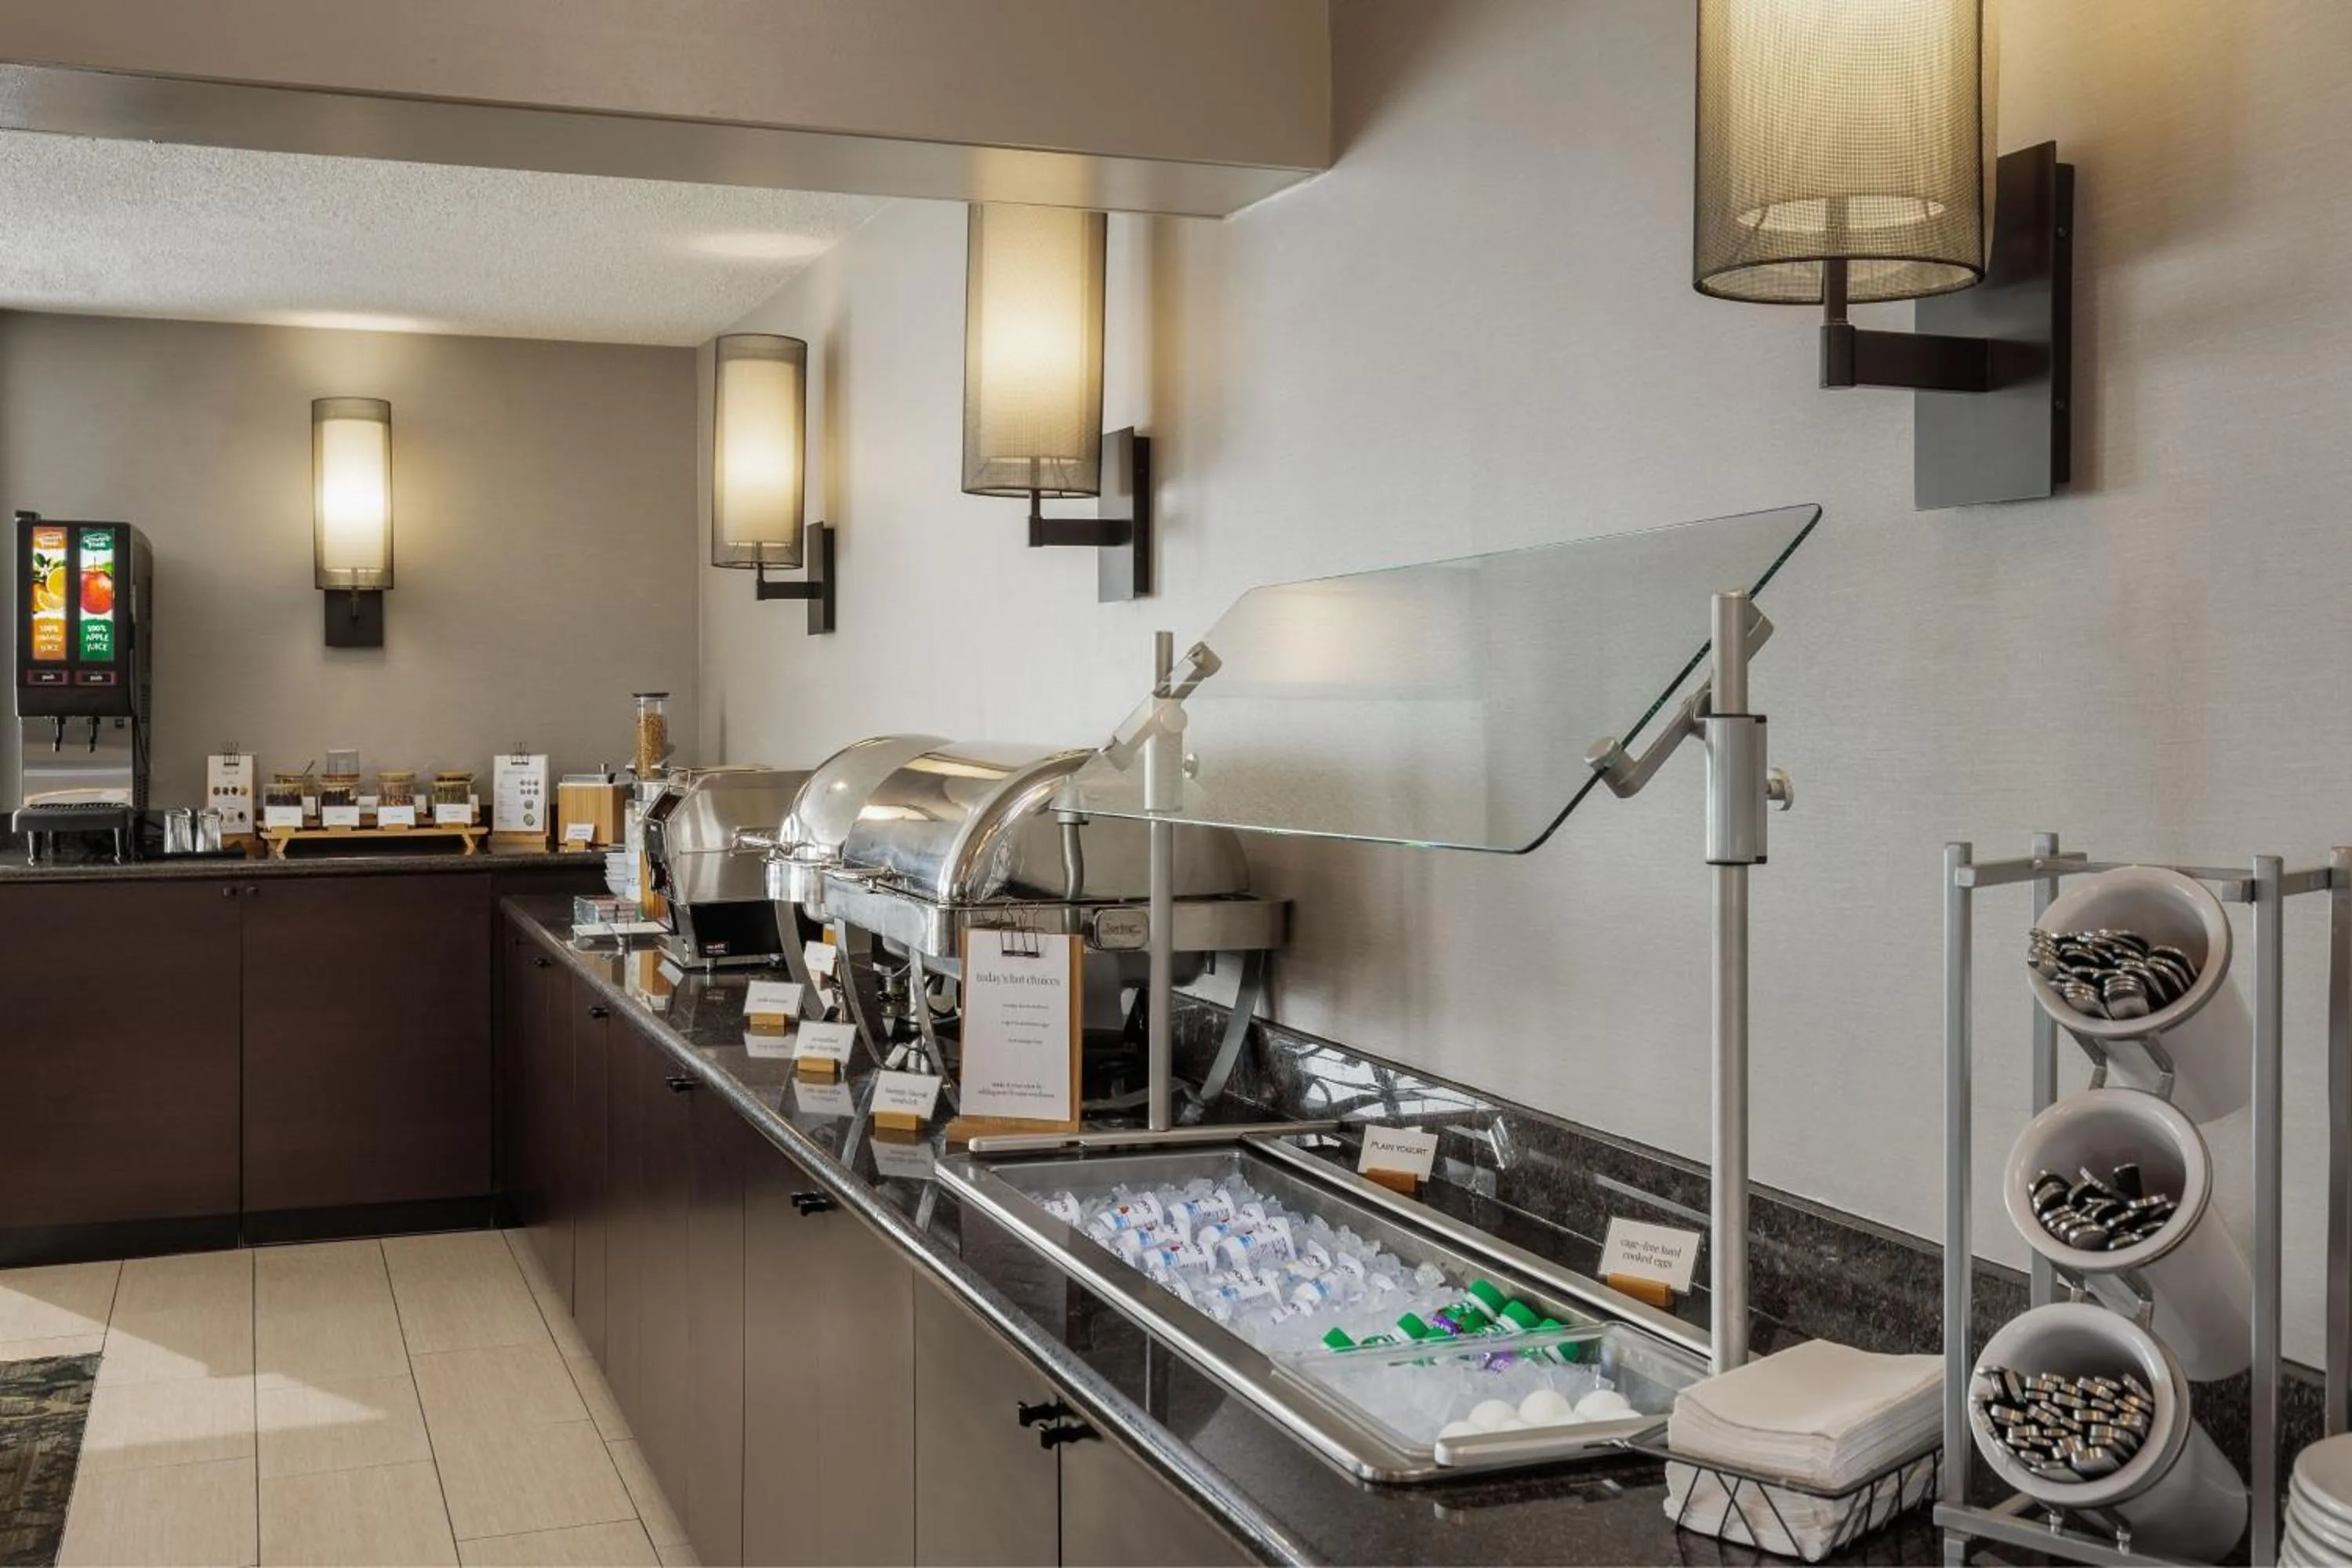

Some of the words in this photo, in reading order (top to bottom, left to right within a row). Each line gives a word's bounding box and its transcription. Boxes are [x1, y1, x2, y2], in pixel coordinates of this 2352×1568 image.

[85, 633, 110, 642] APPLE
[86, 643, 107, 652] JUICE
[976, 972, 1008, 986] today's
[1026, 975, 1061, 986] choices
[1370, 1141, 1394, 1152] PLAIN
[1396, 1145, 1428, 1155] YOGURT
[1620, 1239, 1660, 1253] cage-free
[1661, 1243, 1682, 1258] hard
[1621, 1251, 1653, 1265] cooked
[1653, 1259, 1673, 1269] eggs
